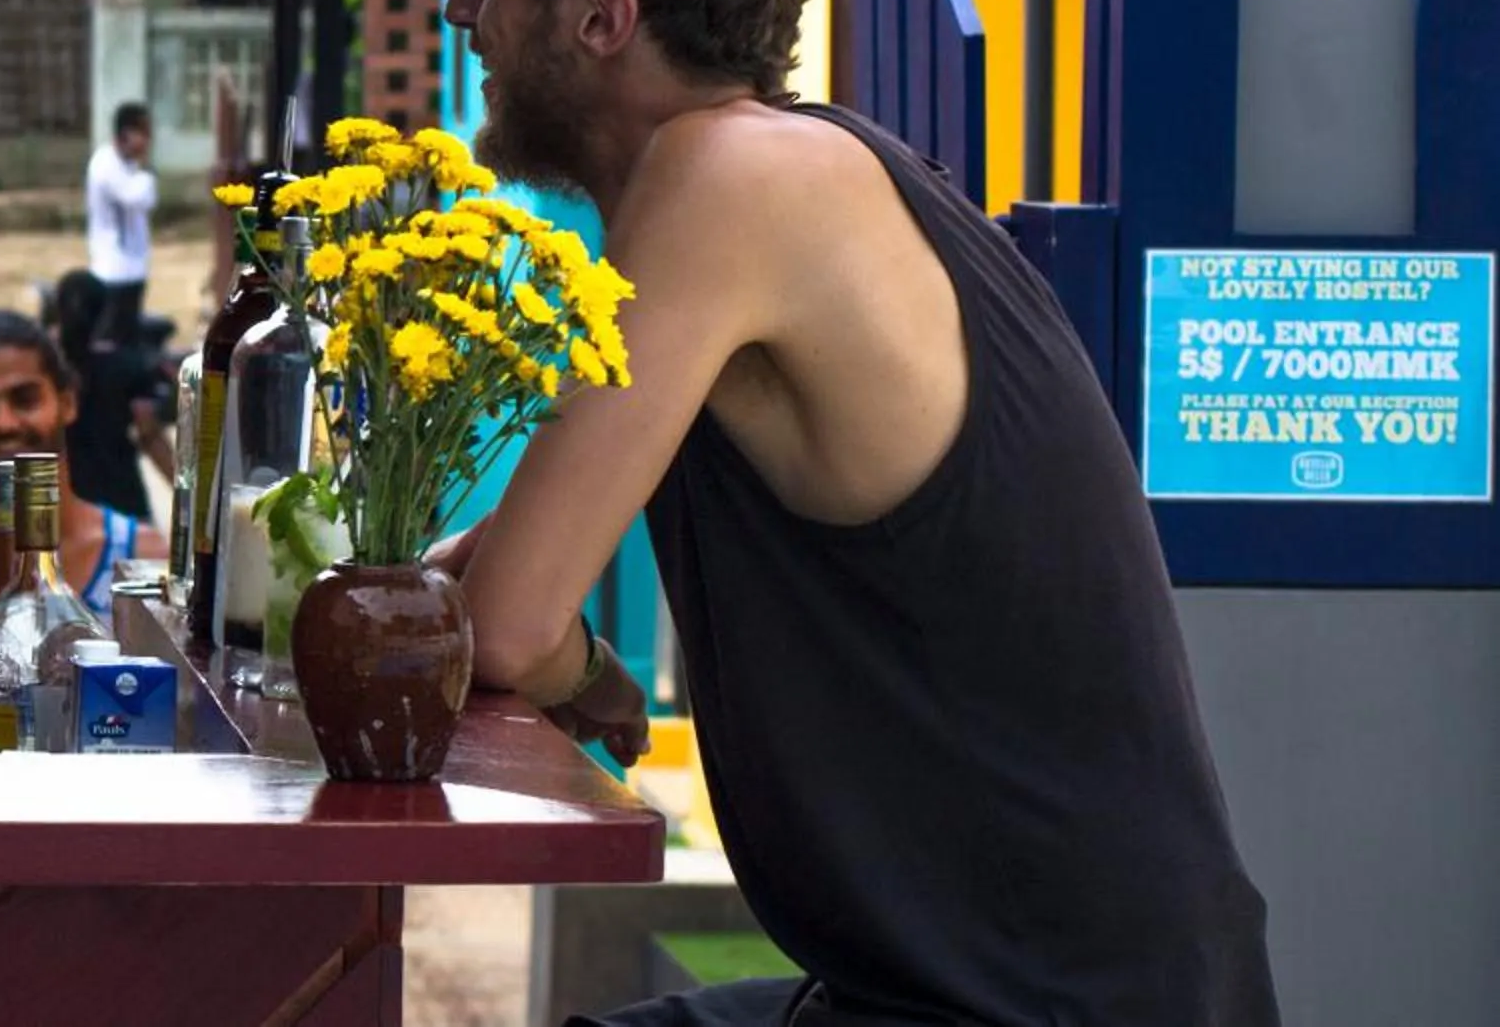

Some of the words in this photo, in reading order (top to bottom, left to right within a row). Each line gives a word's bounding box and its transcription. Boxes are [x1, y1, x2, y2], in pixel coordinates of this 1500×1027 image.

[1181, 258, 1237, 278] NOT
[1242, 259, 1362, 278] STAYING
[1369, 260, 1399, 279] IN
[1405, 260, 1460, 280] OUR
[1208, 280, 1308, 300] LOVELY
[1315, 281, 1432, 301] HOSTEL?
[1178, 319, 1265, 345] POOL
[1273, 320, 1460, 348] ENTRANCE
[1178, 347, 1223, 381] 5$
[1232, 348, 1252, 382] /
[1262, 349, 1460, 381] 7000MMK
[1182, 394, 1248, 409] PLEASE
[1253, 394, 1288, 409] PAY
[1293, 395, 1317, 409] AT
[1320, 395, 1357, 409] OUR
[1361, 395, 1459, 410] RECEPTION
[1179, 410, 1343, 442] THANK
[1354, 411, 1459, 444] YOU!
